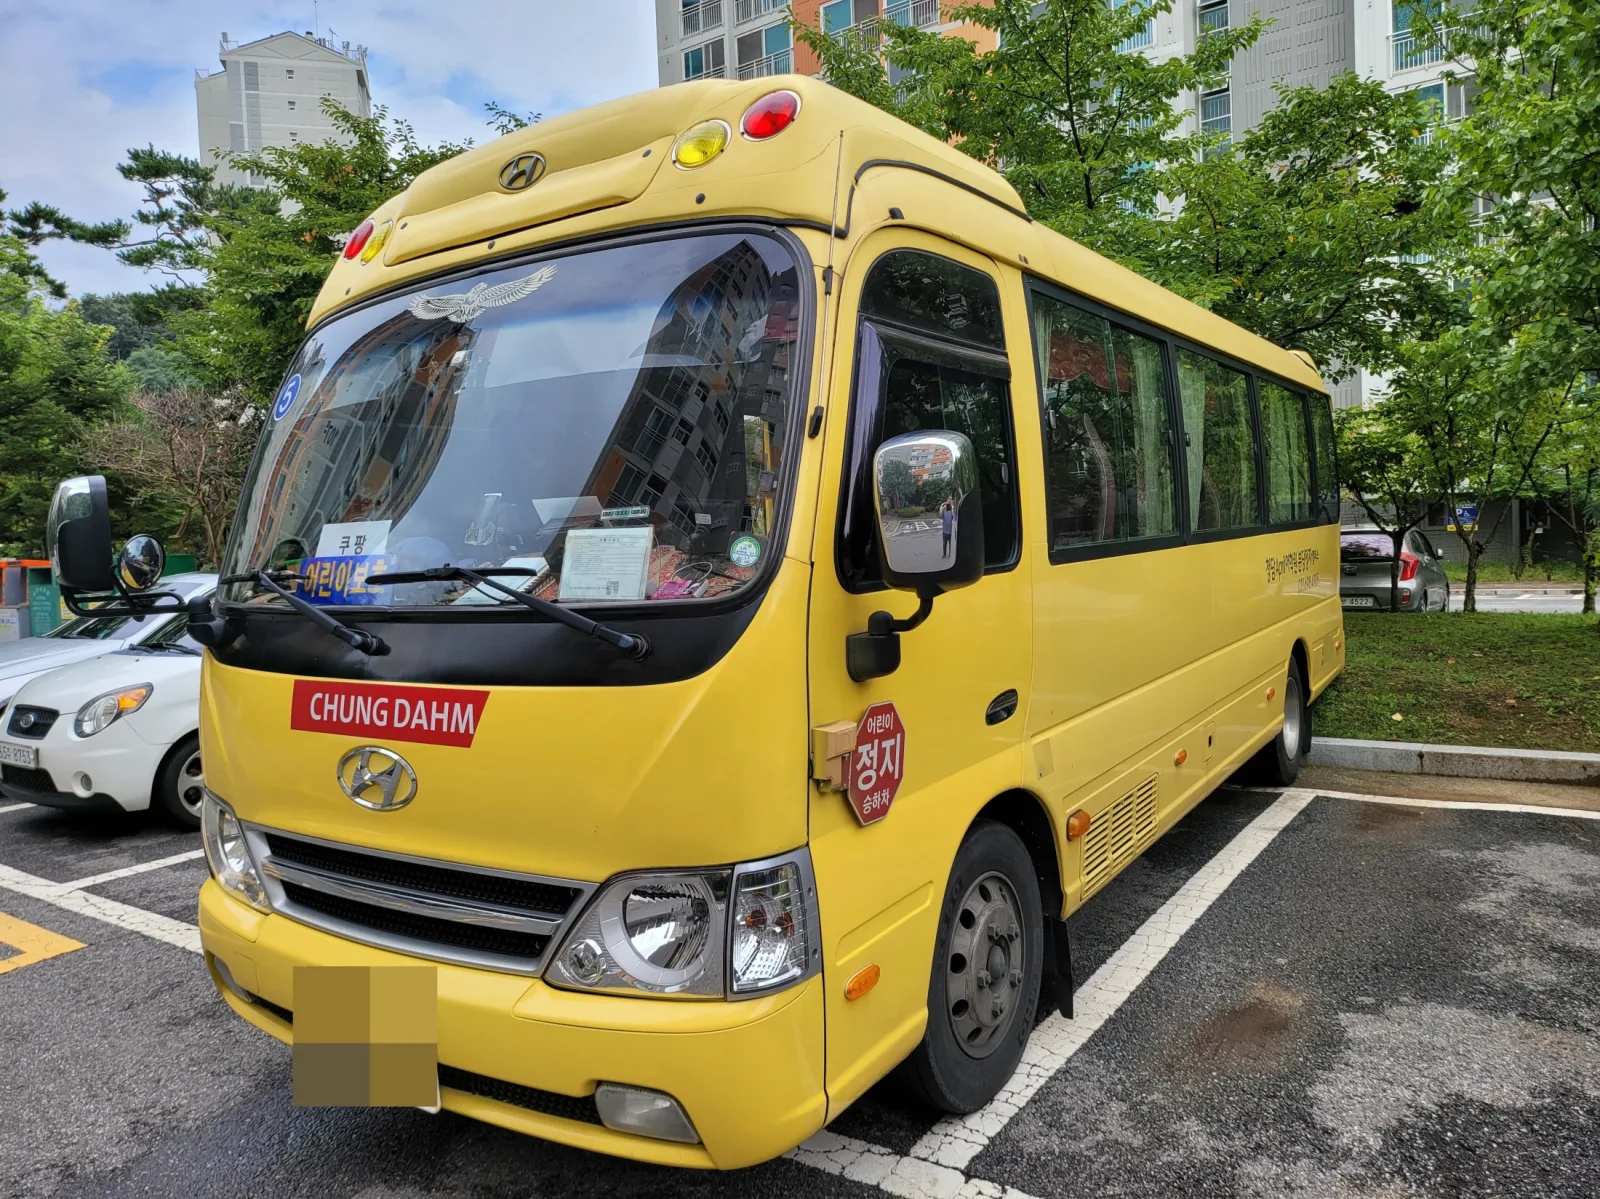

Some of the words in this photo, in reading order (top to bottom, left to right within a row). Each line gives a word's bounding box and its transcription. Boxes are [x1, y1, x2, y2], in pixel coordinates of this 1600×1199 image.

[279, 381, 296, 412] 5
[339, 535, 367, 555] 쿠팡
[310, 692, 389, 727] CHUNG
[393, 698, 475, 735] DAHM
[867, 711, 894, 734] 어린이
[13, 747, 31, 764] 8753
[855, 733, 901, 791] 정지
[862, 787, 890, 815] 승하차
